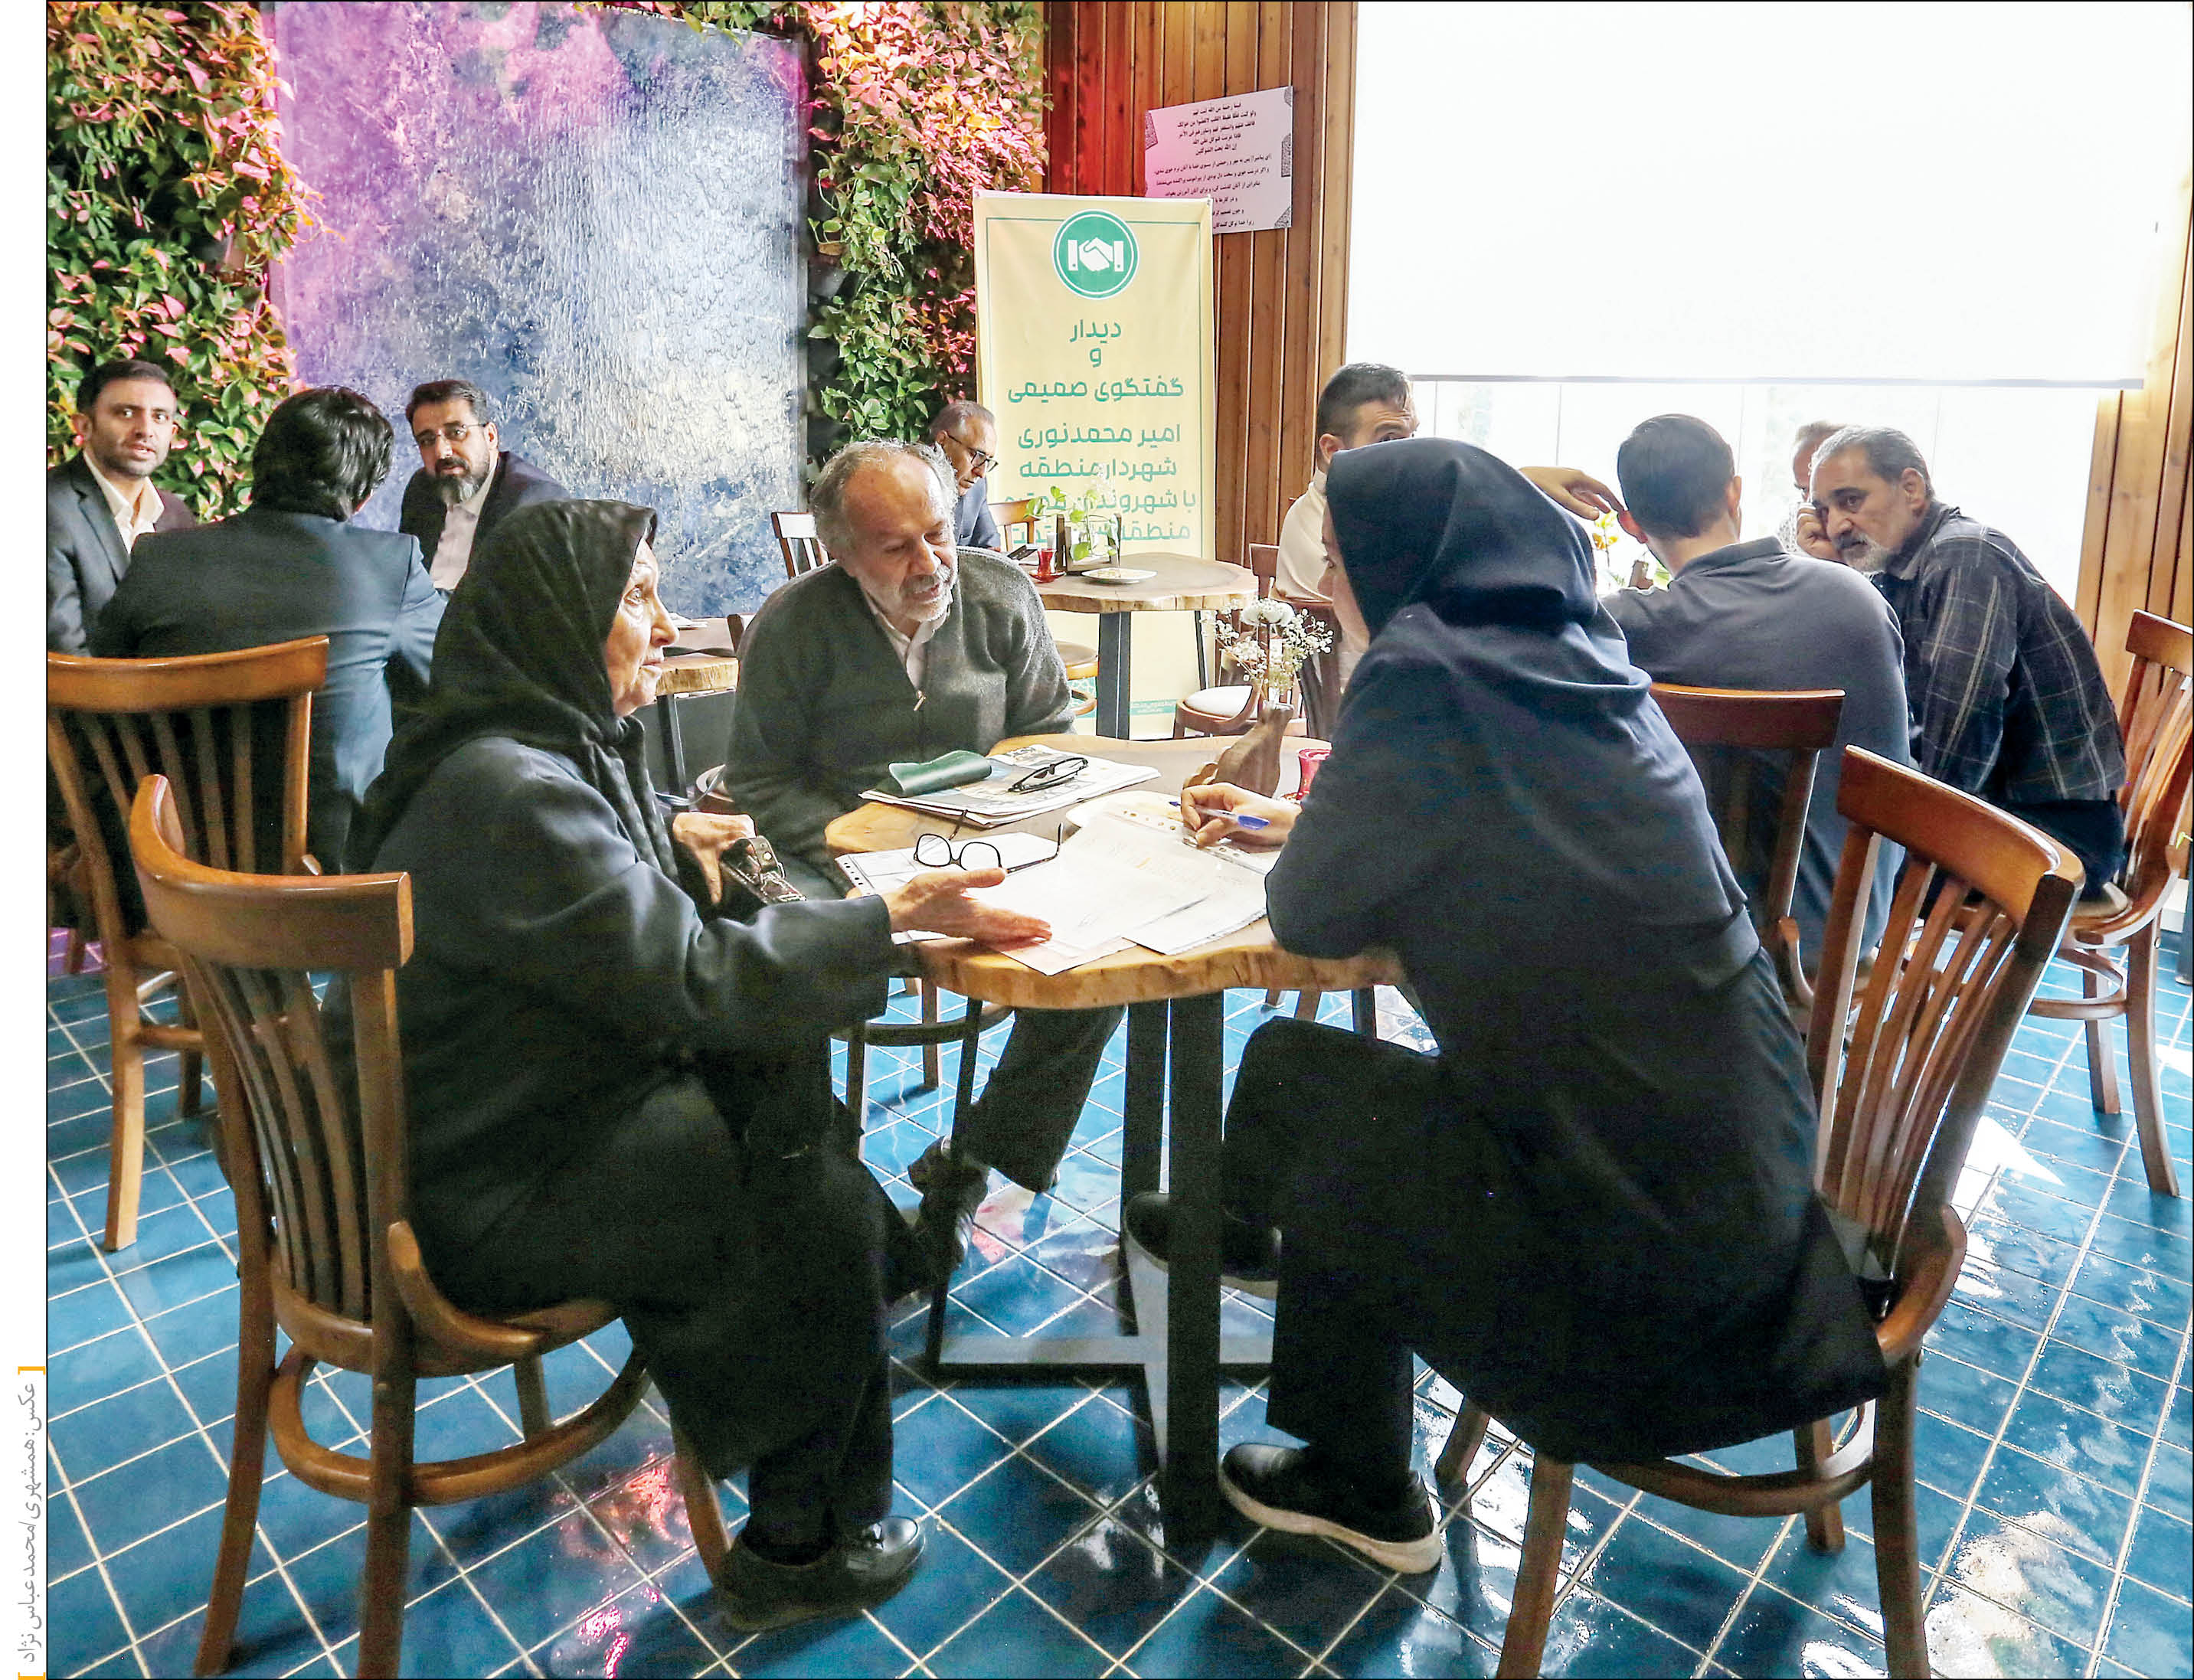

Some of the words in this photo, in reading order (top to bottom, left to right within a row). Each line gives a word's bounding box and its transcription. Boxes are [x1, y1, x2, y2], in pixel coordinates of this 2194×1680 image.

[1069, 319, 1122, 344] دیدار
[1089, 348, 1102, 368] و
[1008, 381, 1087, 403] صمیمی
[1094, 375, 1184, 402] گفتگوی
[1137, 423, 1181, 448] امیر
[1019, 456, 1101, 477] منطقه
[1104, 457, 1178, 482] شهردار
[1182, 489, 1196, 514] با
